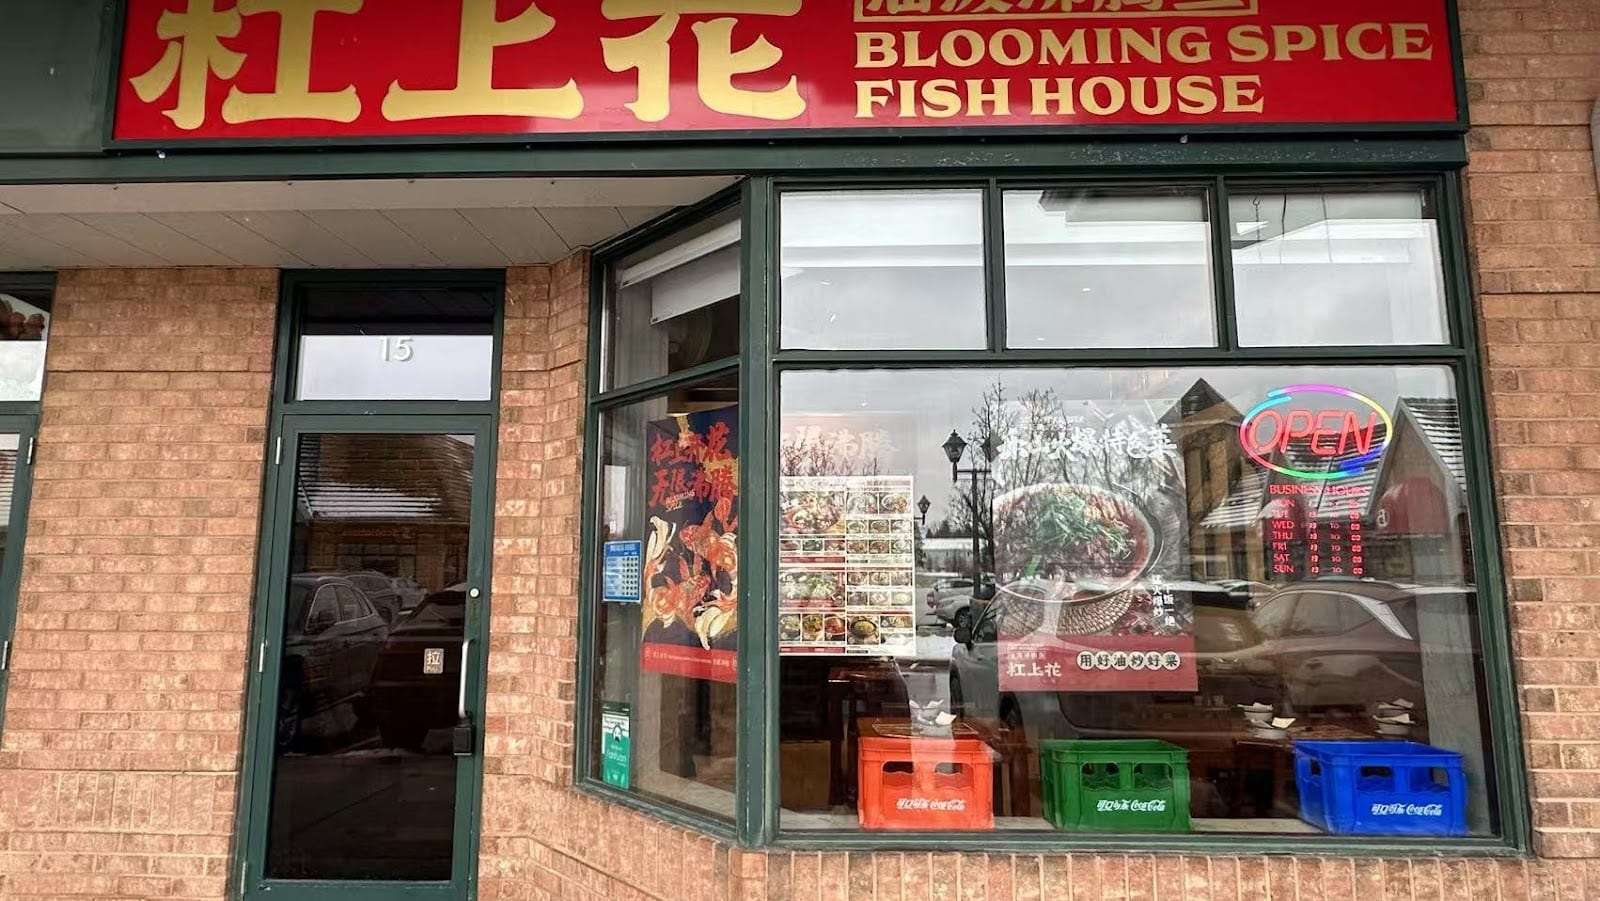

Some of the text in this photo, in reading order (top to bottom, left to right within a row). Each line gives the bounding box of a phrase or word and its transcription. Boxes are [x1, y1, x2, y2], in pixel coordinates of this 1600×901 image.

[853, 22, 1434, 69] BLOOMING SPICE
[853, 75, 1265, 119] FISH HOUSE
[379, 335, 414, 361] 15
[1250, 409, 1378, 456] OPEN
[1269, 484, 1323, 495] BUSINESS
[1271, 520, 1295, 529] WED
[1271, 531, 1293, 540] THU
[1272, 542, 1287, 551] FRI
[1273, 553, 1290, 563] SAT
[1273, 564, 1295, 573] SUN
[426, 651, 441, 665] 拉
[1078, 653, 1179, 668] 用好油炒好菜
[1006, 662, 1062, 677] 杠上花
